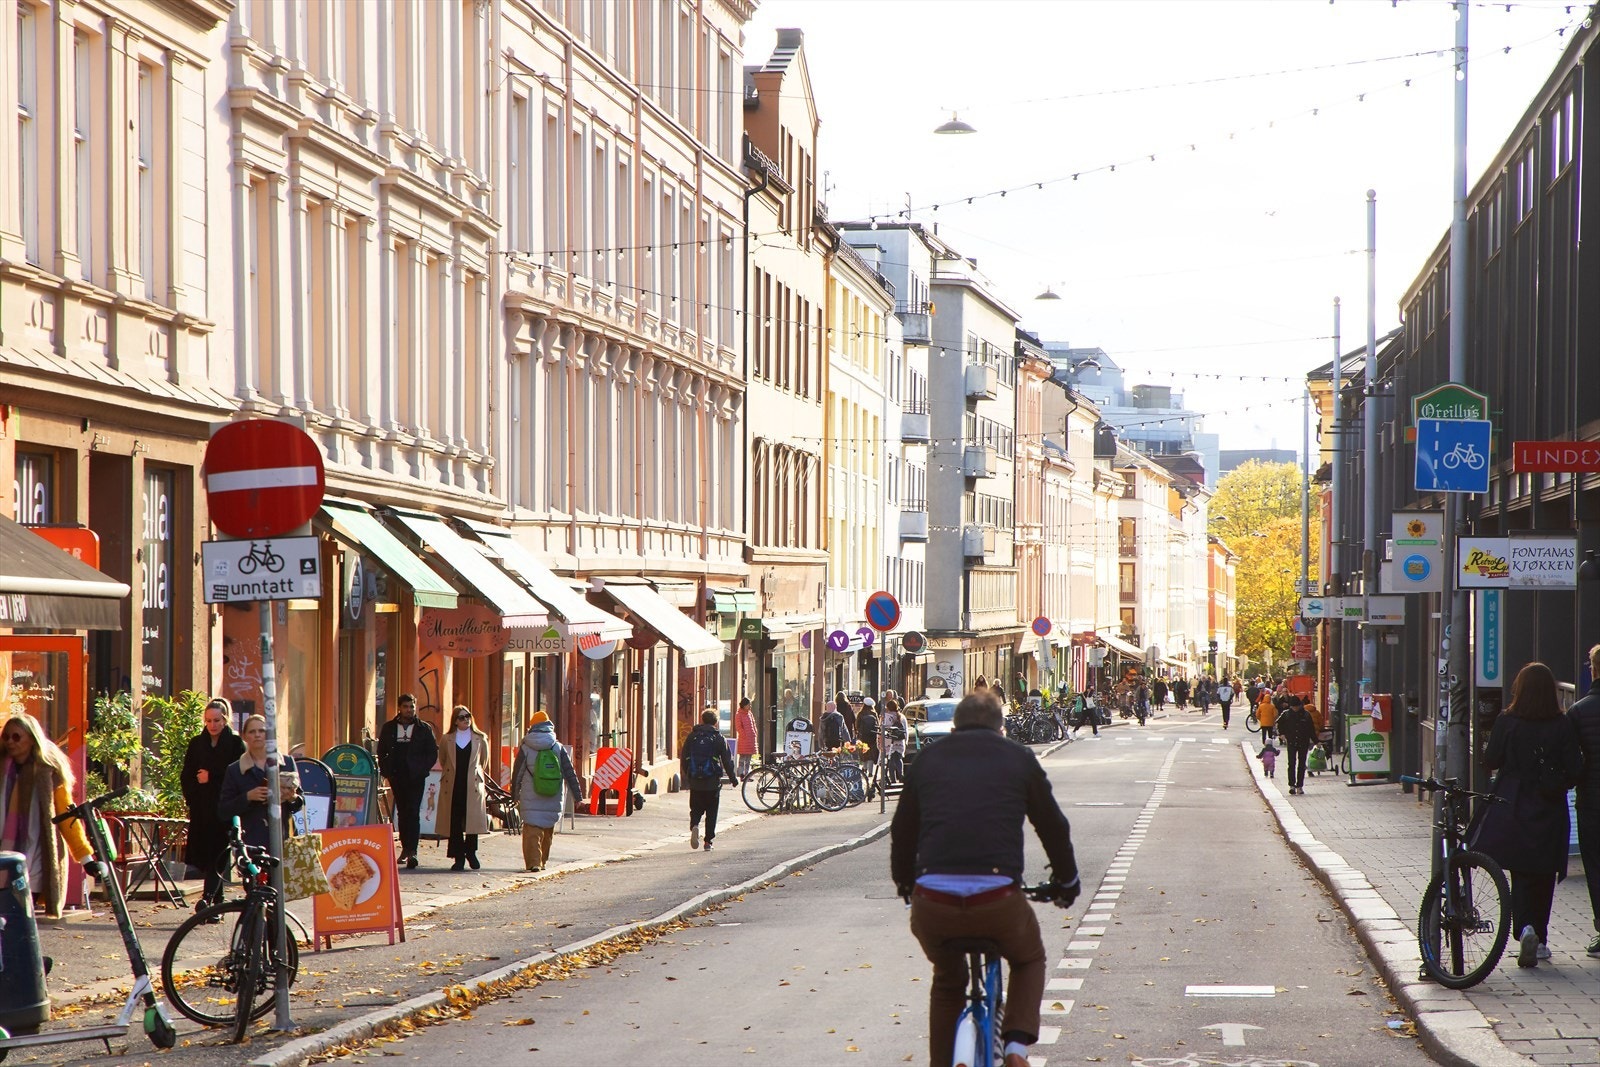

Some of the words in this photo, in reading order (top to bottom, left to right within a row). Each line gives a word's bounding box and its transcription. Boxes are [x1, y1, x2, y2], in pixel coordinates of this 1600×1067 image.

[1512, 546, 1575, 559] FONTANAS
[1512, 560, 1575, 572] KJØKKEN
[231, 578, 294, 595] unntatt
[507, 636, 566, 649] sunkost
[1487, 628, 1495, 673] Brun
[363, 839, 382, 850] DIGG
